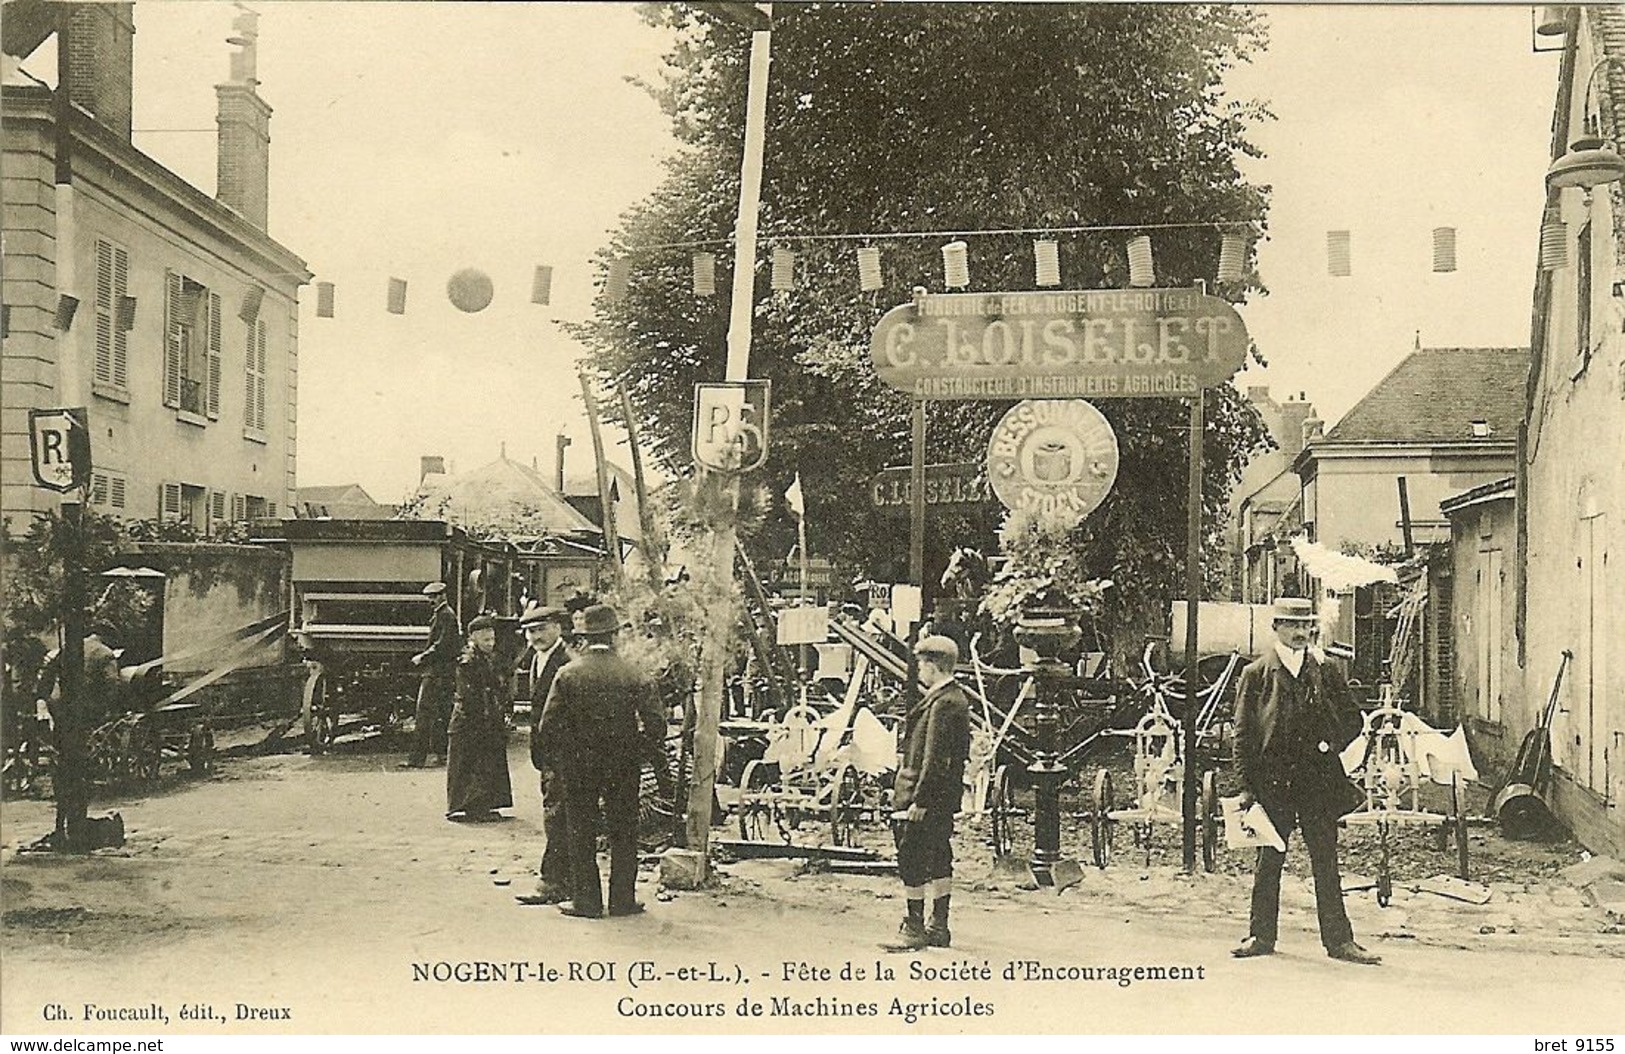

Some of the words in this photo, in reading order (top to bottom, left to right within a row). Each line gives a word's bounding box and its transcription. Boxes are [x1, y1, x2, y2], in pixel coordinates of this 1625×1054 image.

[918, 297, 985, 316] FONDERIE
[1001, 296, 1028, 315] FER
[1045, 293, 1160, 314] NOGENT-LE-ROI
[885, 320, 931, 369] C.
[936, 316, 1234, 369] LOISELET
[915, 376, 1018, 397] CONSTRUCTEUR
[1018, 374, 1119, 396] D'INSTRUMENTS
[1122, 370, 1198, 394] AGRICOLES
[891, 476, 992, 504] LSELE
